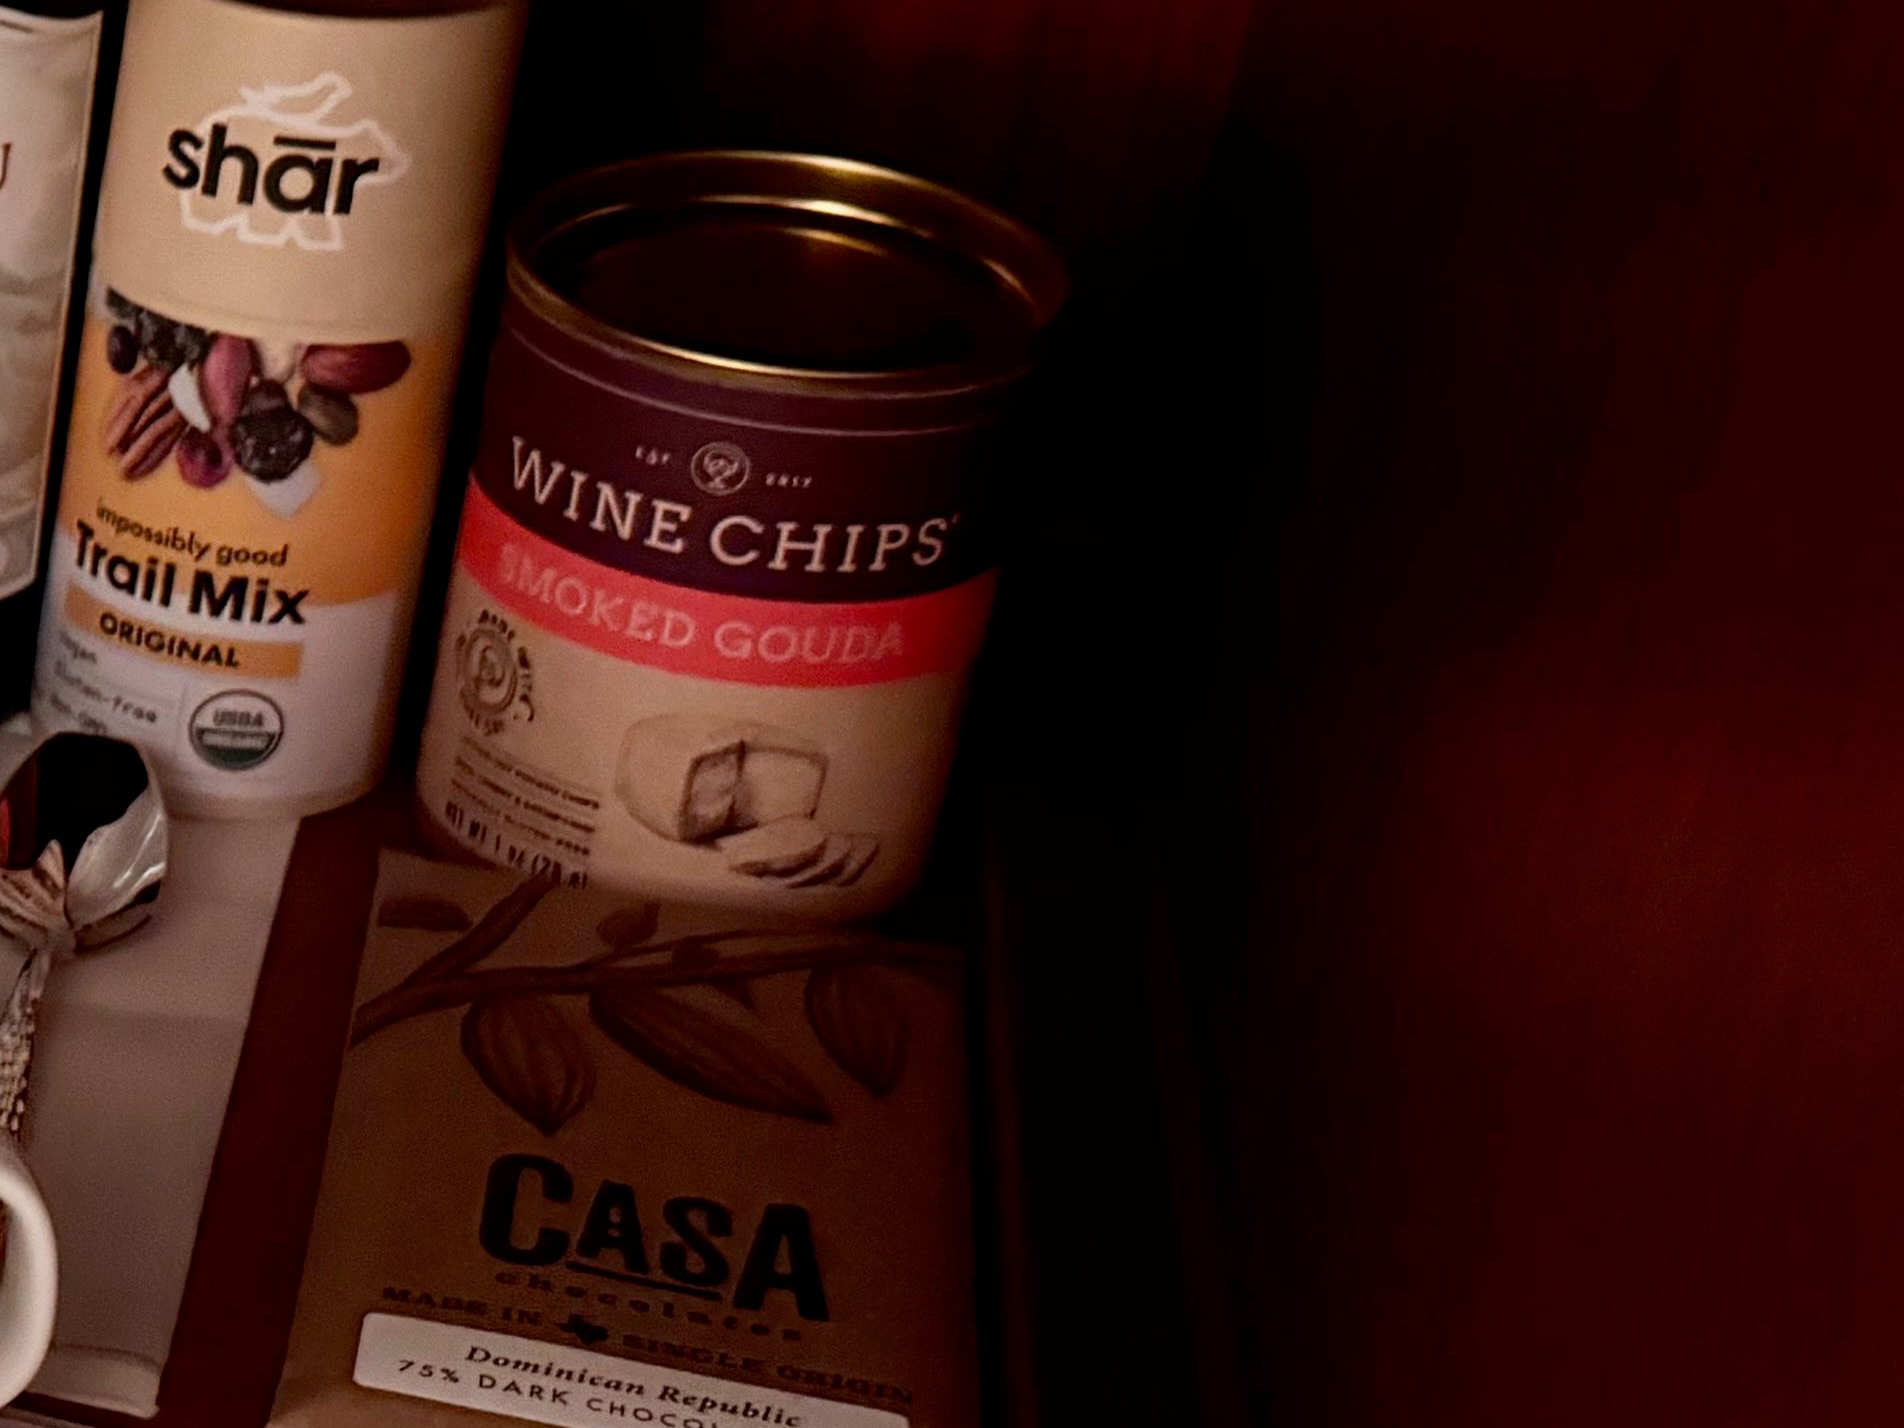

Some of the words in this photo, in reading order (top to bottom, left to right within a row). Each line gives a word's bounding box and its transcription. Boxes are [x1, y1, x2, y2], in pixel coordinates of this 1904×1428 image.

[162, 125, 382, 215] shār
[96, 496, 210, 560] impossibly
[217, 544, 288, 566] good
[511, 436, 692, 554] WINE
[709, 515, 947, 572] CHIPS
[77, 520, 175, 606] Trail
[190, 571, 309, 623] Mix
[496, 543, 694, 649] SMOKED
[713, 622, 903, 664] GOUDA
[100, 613, 239, 667] ORIGINAL
[478, 1153, 830, 1321] CASA
[399, 1360, 459, 1383] 75%
[479, 1375, 567, 1405] DARK
[465, 1346, 644, 1398] Dominican
[658, 1385, 801, 1428] Republic
